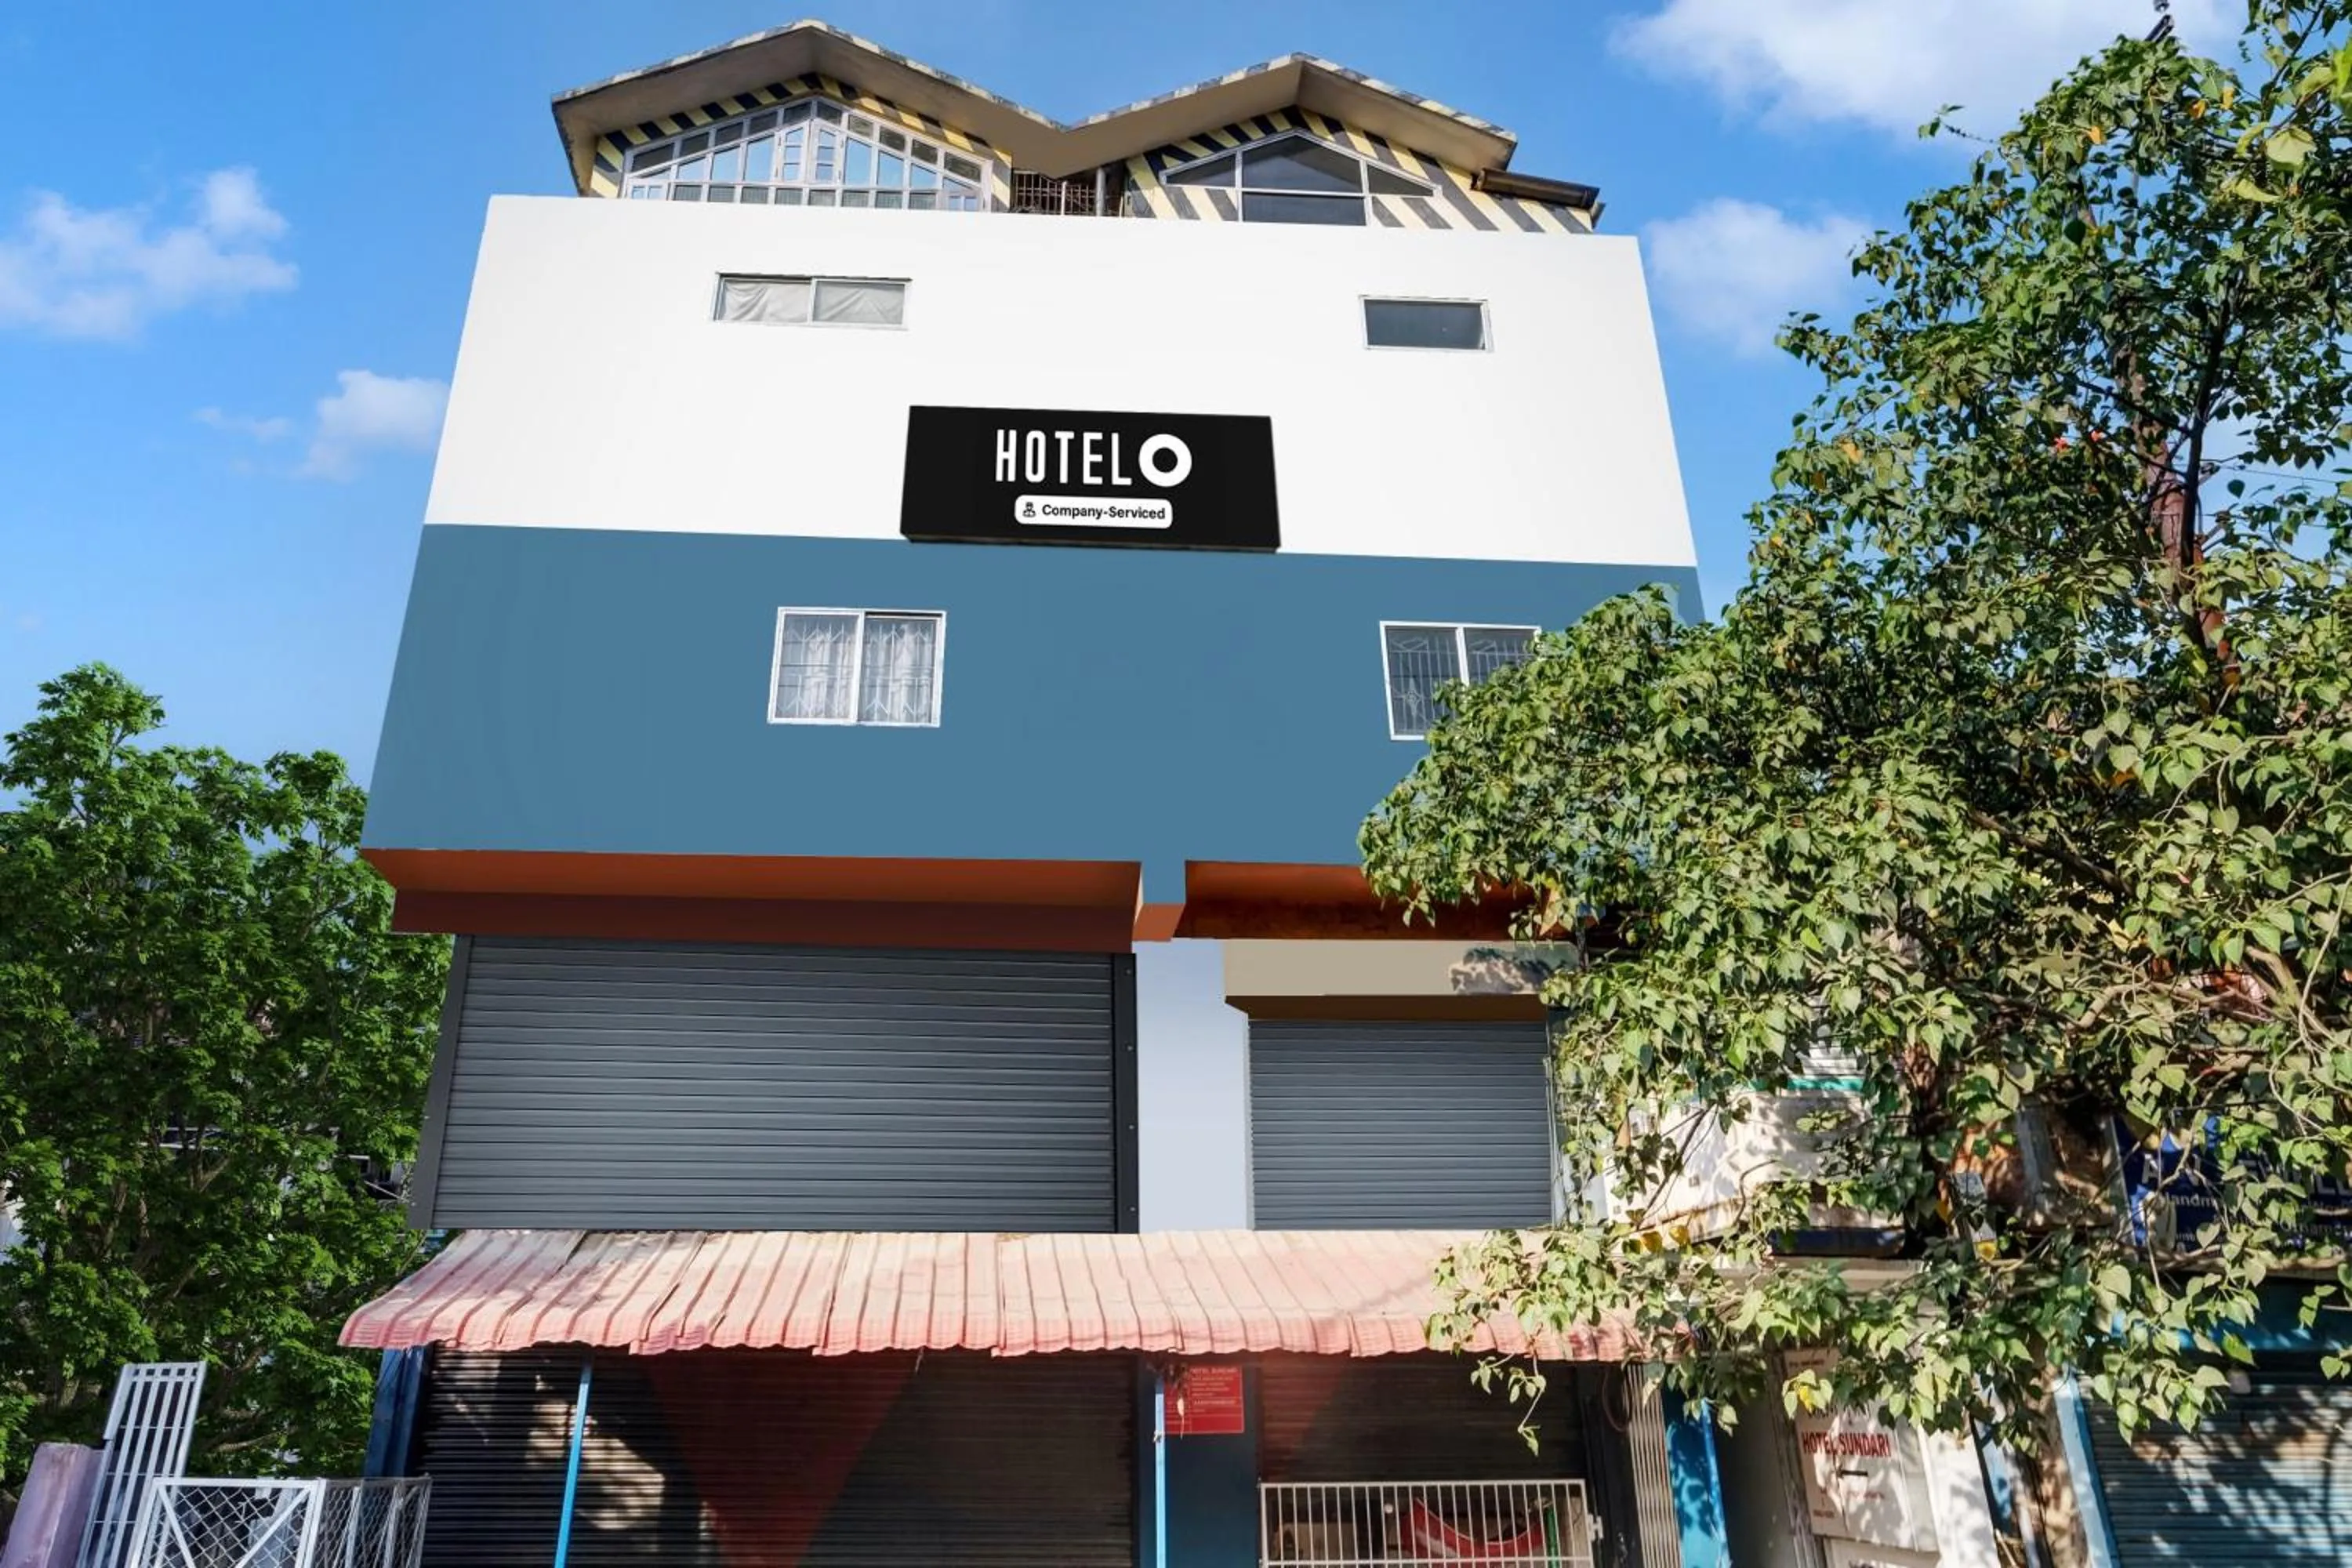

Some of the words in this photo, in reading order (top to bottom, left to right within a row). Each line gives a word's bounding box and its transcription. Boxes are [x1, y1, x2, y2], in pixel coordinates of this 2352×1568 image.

[996, 429, 1133, 486] HOTEL
[1042, 504, 1166, 521] Company-Serviced
[1802, 1431, 1838, 1455] HOTEL
[1838, 1432, 1891, 1457] SUNDARI
